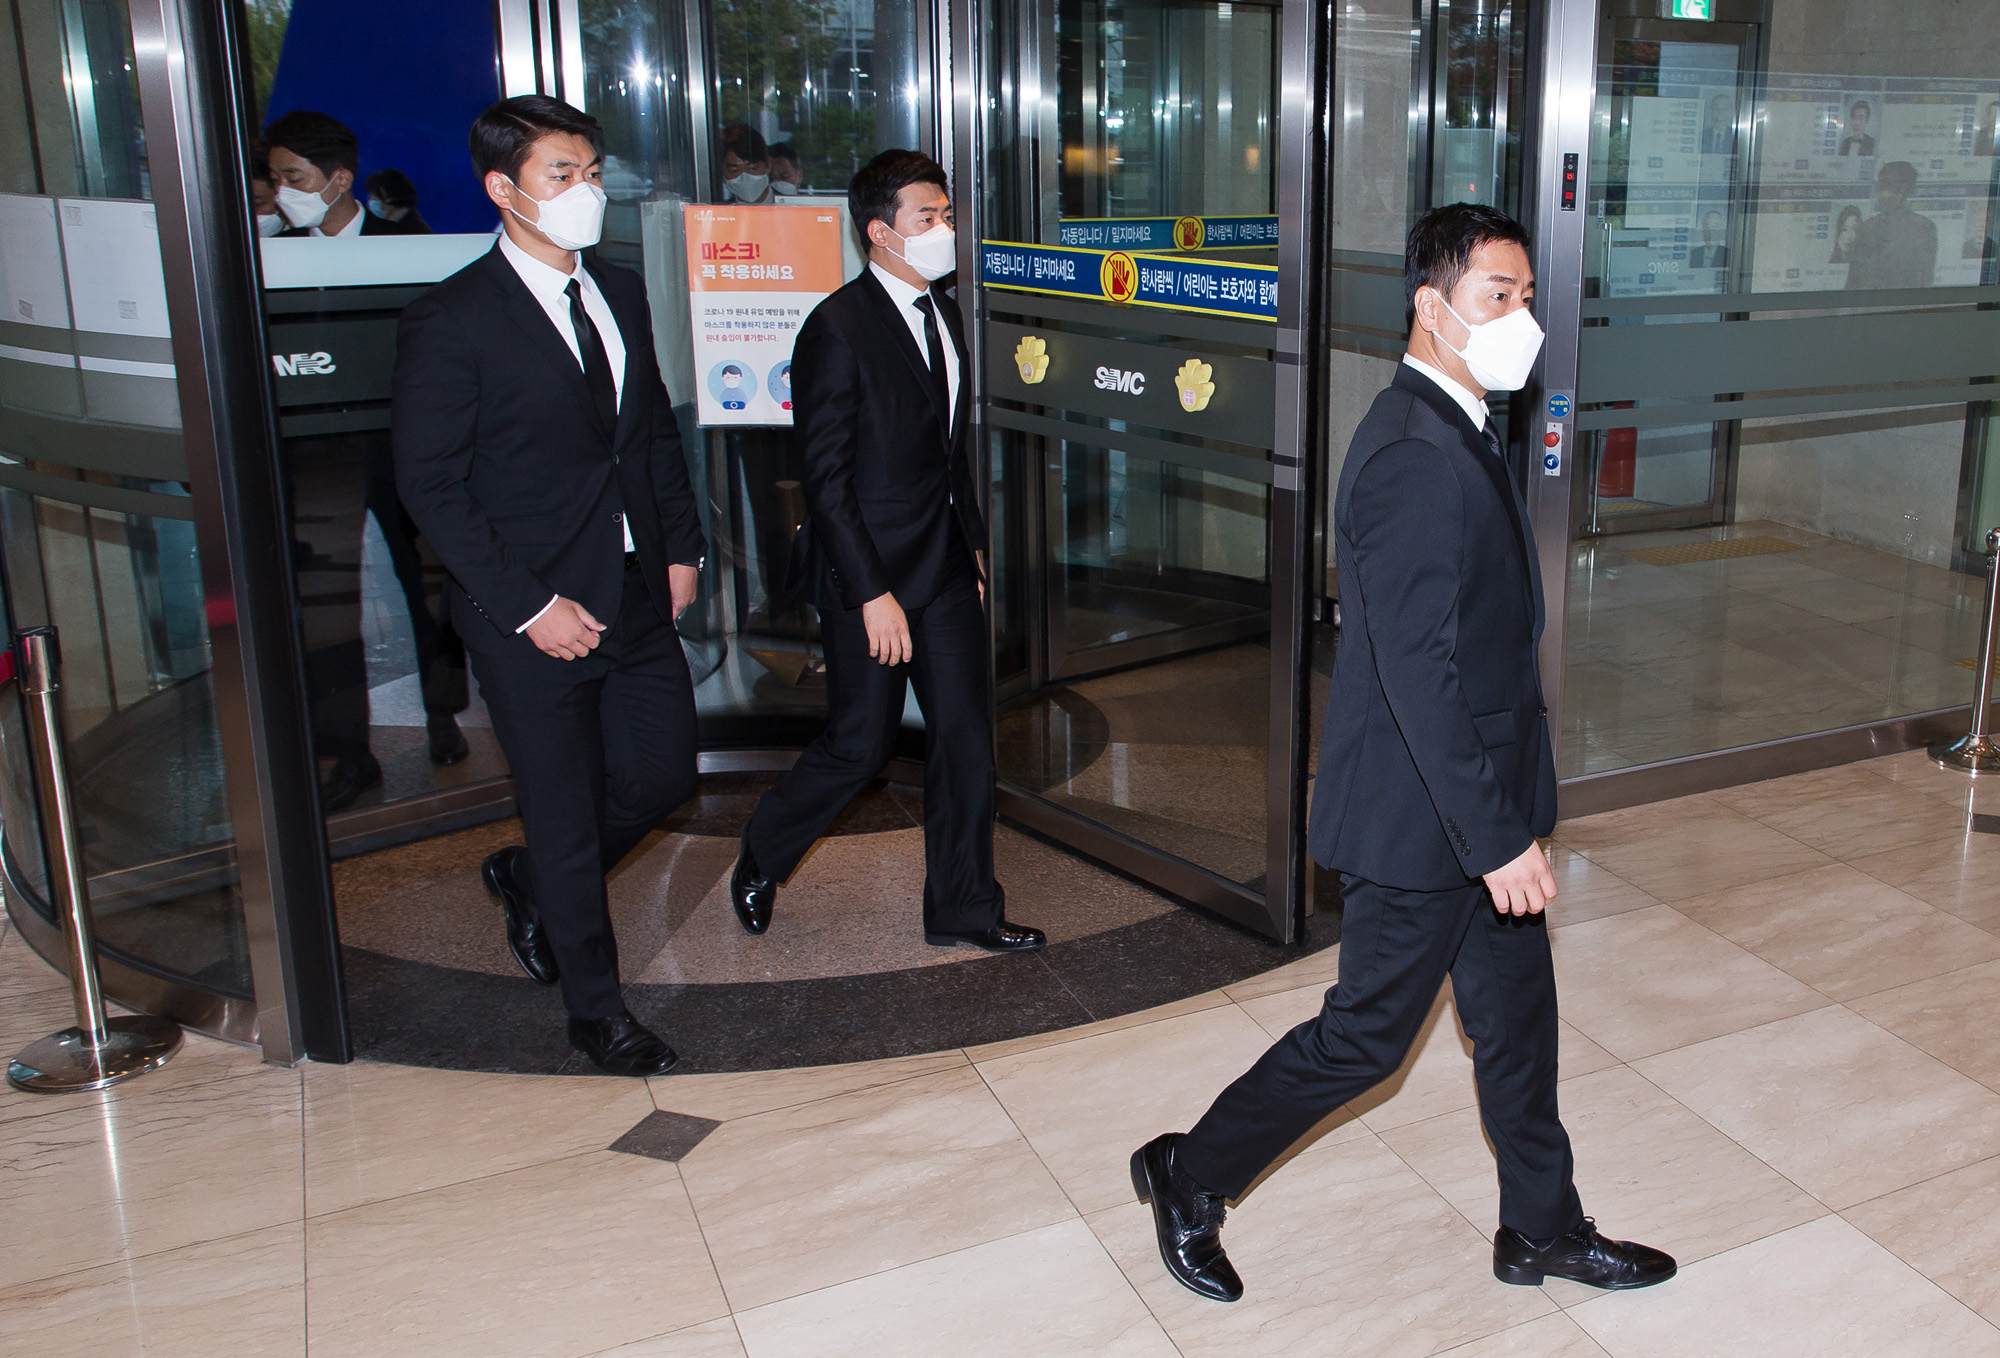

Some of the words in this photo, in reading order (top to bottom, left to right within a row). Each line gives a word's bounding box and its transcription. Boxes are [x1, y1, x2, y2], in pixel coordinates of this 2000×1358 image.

[1061, 227, 1103, 245] 자동입니다
[1111, 226, 1151, 243] 밀지마세요
[1207, 224, 1233, 241] 한사람씩
[1240, 223, 1265, 240] 어린이는
[701, 242, 760, 260] 마스크!
[701, 264, 717, 280] 꼭
[720, 264, 795, 280] 착용하세요
[985, 252, 1025, 277] 자동입니다
[1033, 256, 1076, 281] 밀지마세요
[1141, 267, 1174, 295] 한사람씩
[1183, 272, 1218, 299] 어린이는
[1220, 277, 1257, 304] 보호자와
[1259, 280, 1278, 307] 함께
[704, 308, 725, 316] 코로나
[726, 308, 734, 316] 19
[735, 308, 749, 316] 원내
[750, 308, 764, 316] 유입
[765, 308, 785, 316] 예방을
[787, 308, 800, 316] 위해
[704, 321, 732, 329] 마스크를
[734, 321, 761, 329] 착용하지
[762, 321, 776, 329] 않은
[777, 321, 797, 330] 분들은
[706, 334, 719, 342] 원내
[721, 334, 742, 342] 출입이
[744, 334, 779, 342] 불가합니다.
